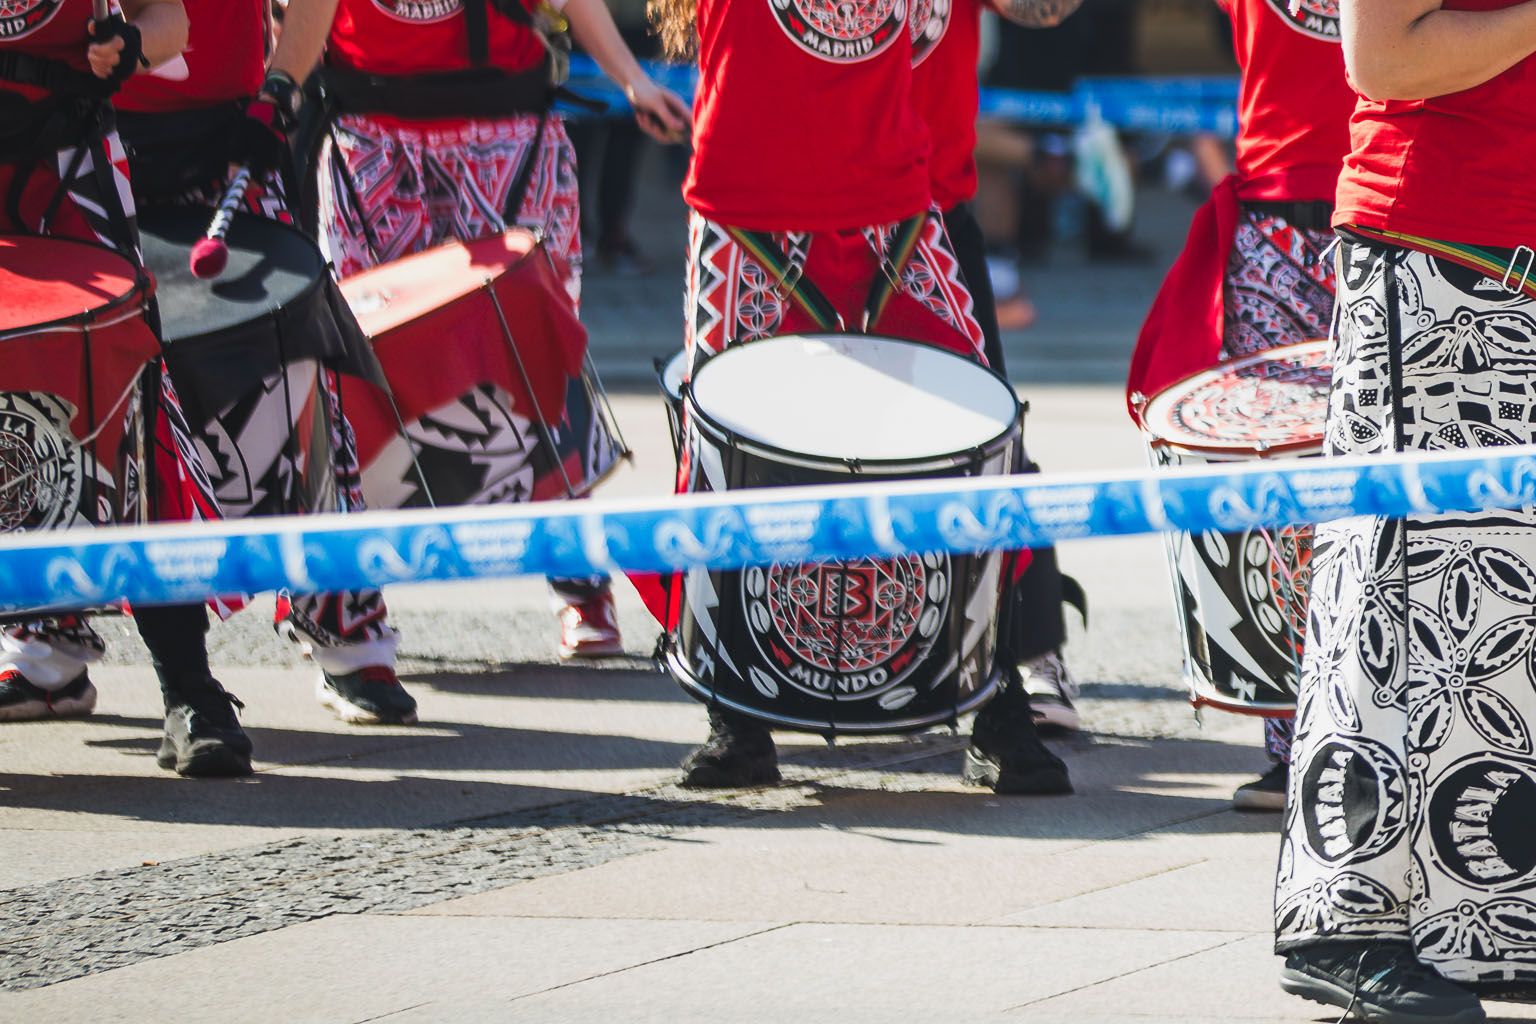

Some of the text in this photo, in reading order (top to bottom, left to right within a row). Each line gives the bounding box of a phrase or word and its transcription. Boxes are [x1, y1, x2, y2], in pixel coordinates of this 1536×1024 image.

[803, 30, 874, 58] MADRID
[790, 663, 889, 694] MUNDO
[1314, 749, 1355, 858] BATALA
[1448, 770, 1522, 880] BATALA
